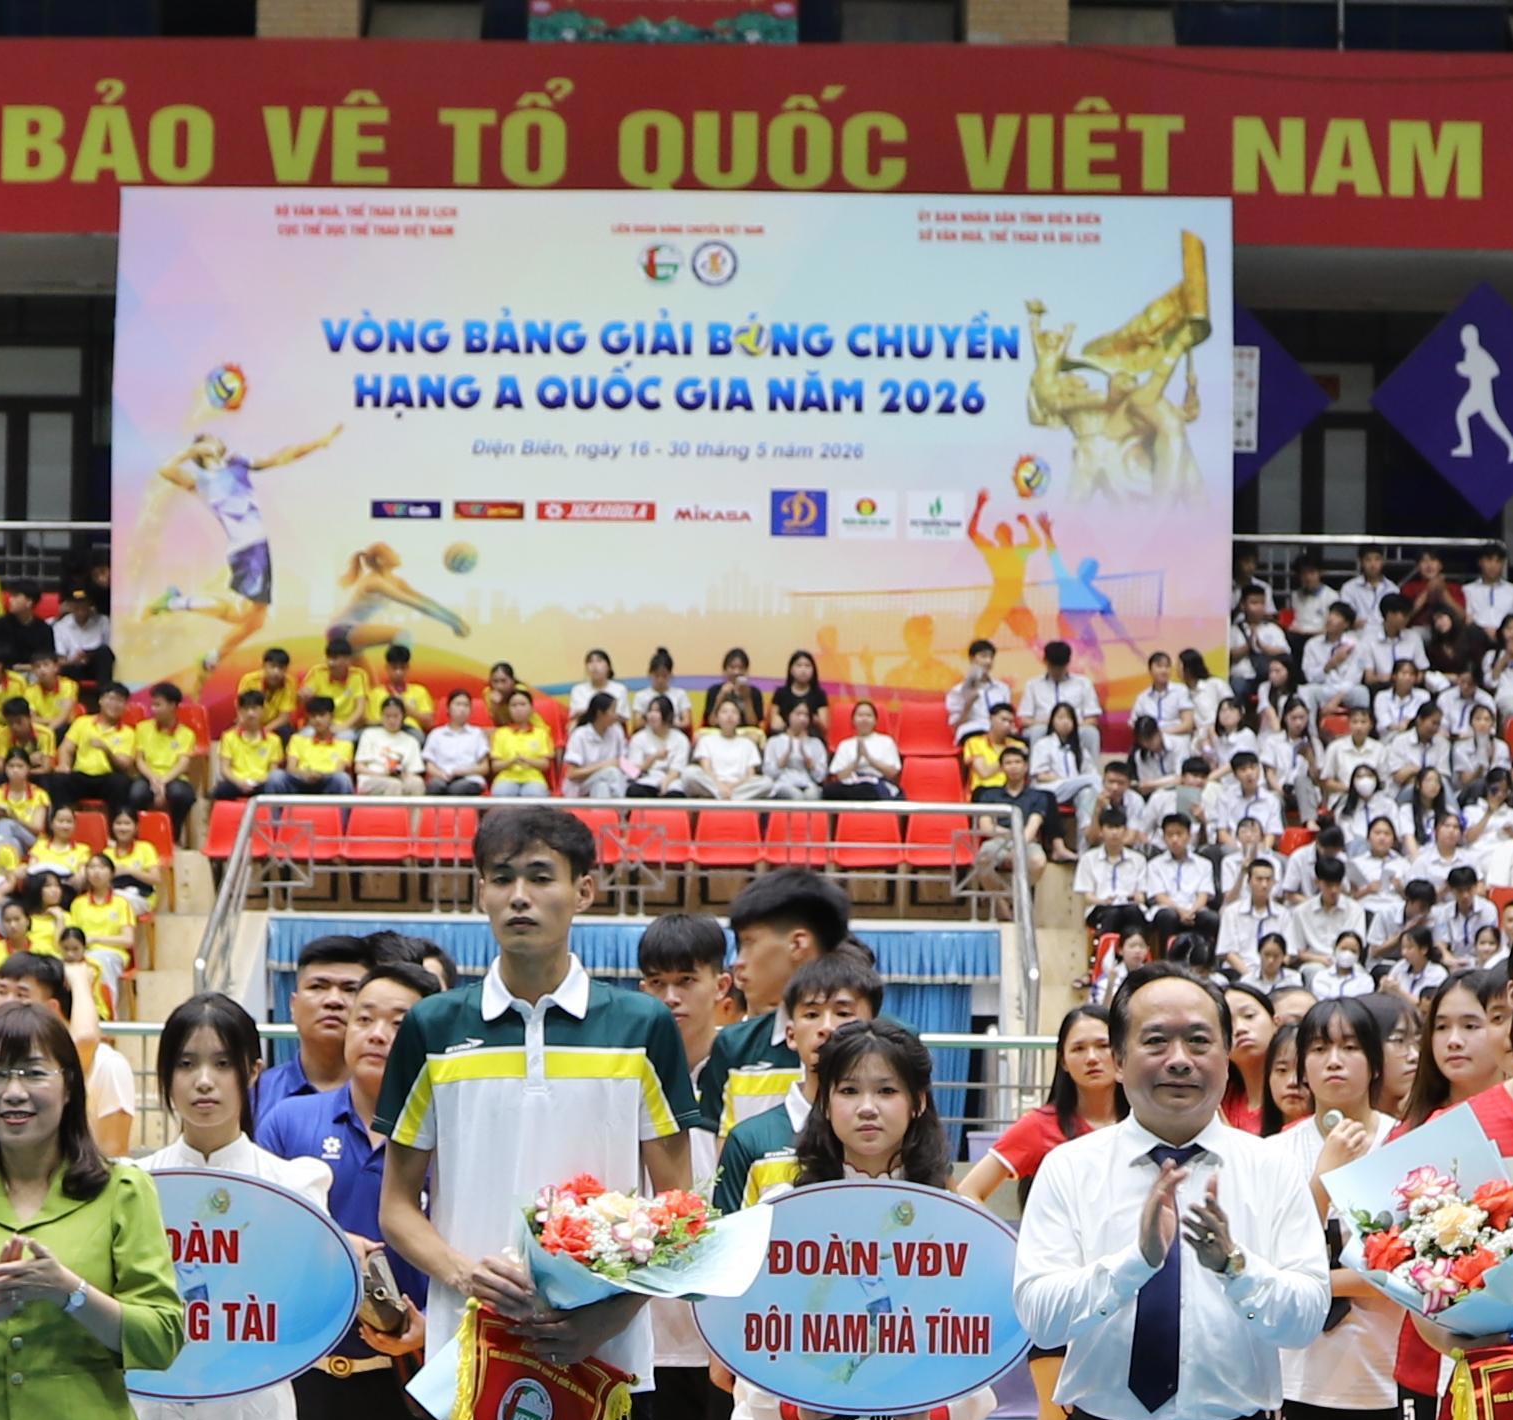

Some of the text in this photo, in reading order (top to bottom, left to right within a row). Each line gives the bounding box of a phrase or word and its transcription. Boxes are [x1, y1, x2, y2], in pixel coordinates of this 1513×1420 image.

[0, 79, 214, 184] BẢO
[439, 77, 573, 187] TỔ
[616, 85, 908, 191] QUỐC
[1232, 116, 1482, 198] NAM
[321, 310, 450, 353] VÒNG
[463, 308, 587, 355] BẢNG
[600, 308, 693, 356] GIẢI
[847, 311, 1020, 360] CHUYỀN
[354, 360, 986, 418] HẠNG A QUỐC GIA NĂM 2026
[575, 441, 621, 460] ngày
[629, 441, 650, 457] 16
[668, 441, 691, 457] 30
[696, 441, 750, 461] tháng
[772, 443, 813, 459] năm
[819, 442, 864, 459] 2026
[166, 1221, 239, 1264] OÀN
[768, 1234, 969, 1278] ĐOÀN VĐV
[222, 1293, 276, 1342] TÀI
[744, 1307, 991, 1360] ĐỘI NAM HÀ TĨNH
